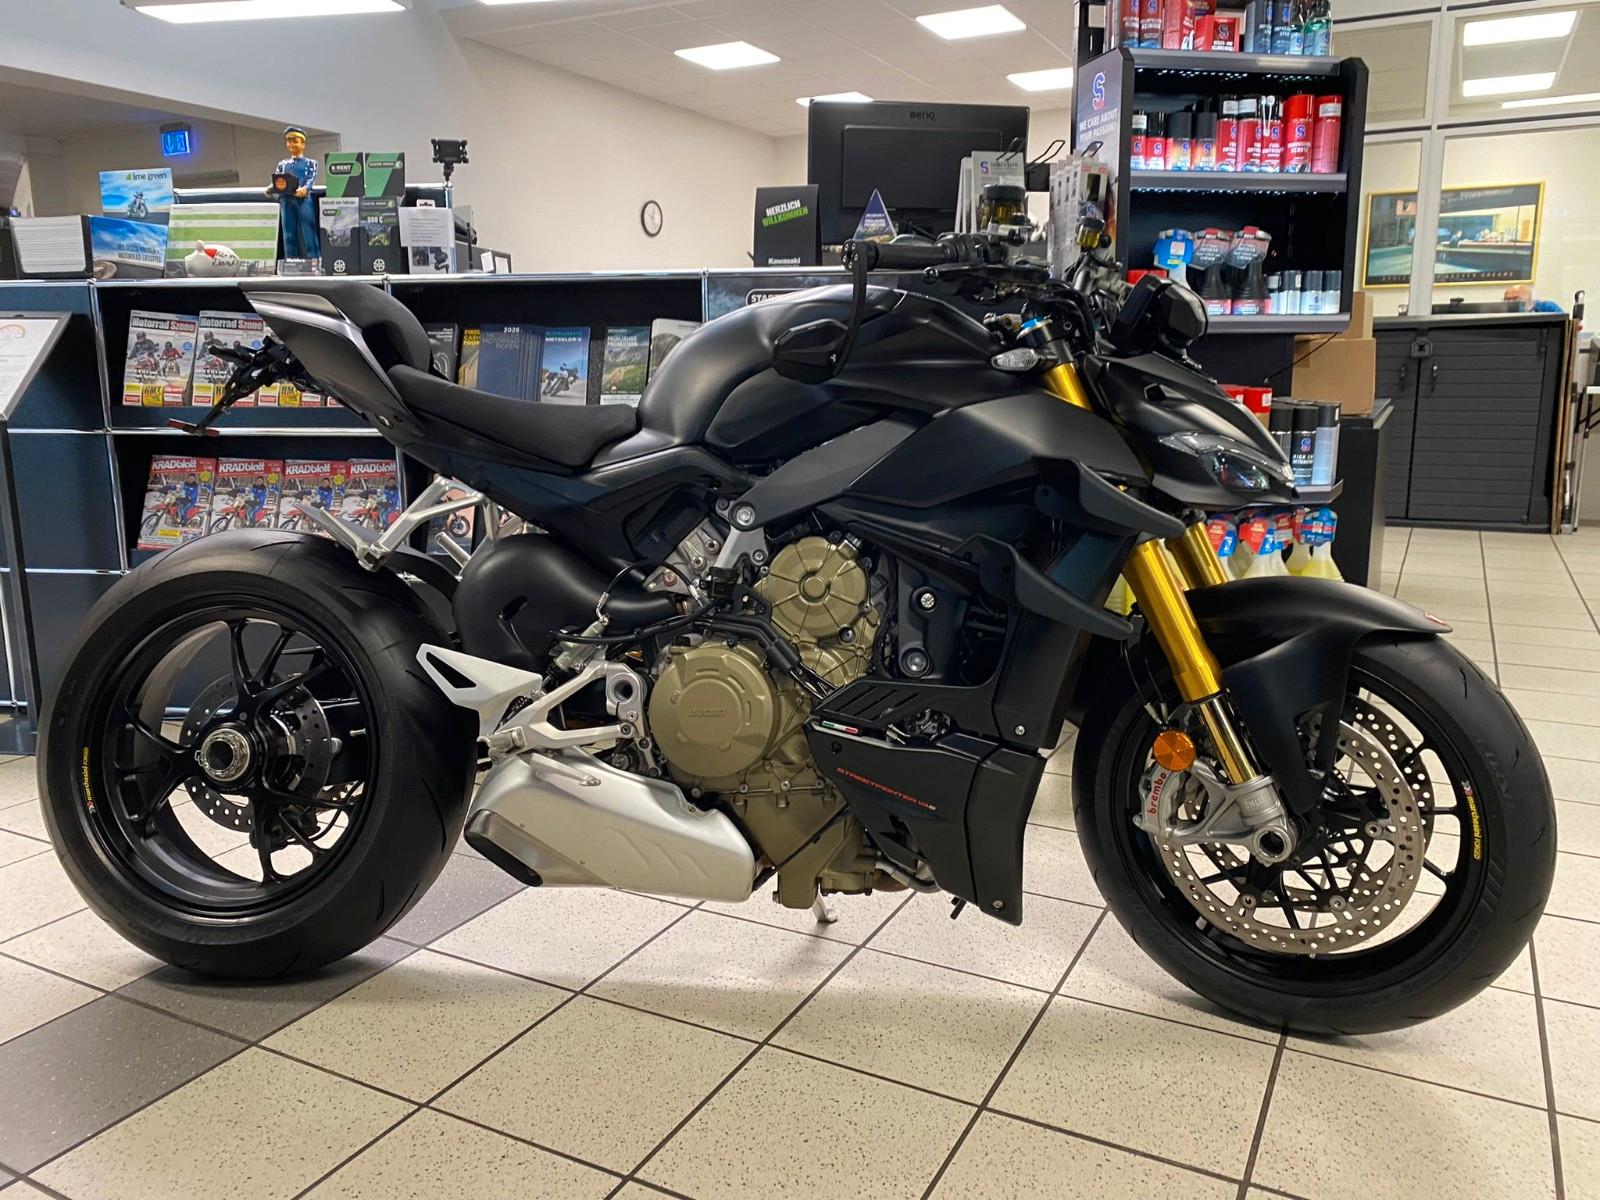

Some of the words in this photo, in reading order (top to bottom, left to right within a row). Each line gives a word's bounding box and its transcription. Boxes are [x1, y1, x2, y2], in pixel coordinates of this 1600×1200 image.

[766, 200, 801, 217] HERZLICH
[762, 207, 808, 227] WILLKOMMEN
[768, 257, 800, 265] Kawasaki
[132, 317, 169, 329] Motorrad
[170, 320, 195, 332] Szene
[200, 318, 237, 328] Motorrad
[238, 320, 262, 330] Szene
[152, 459, 197, 471] KRADblatt
[219, 462, 264, 473] KRADblatt
[285, 463, 330, 475] KRADblatt
[350, 463, 396, 474] KRADblatt
[836, 767, 917, 803] STREETFIGHTER
[1138, 773, 1167, 814] brembo
